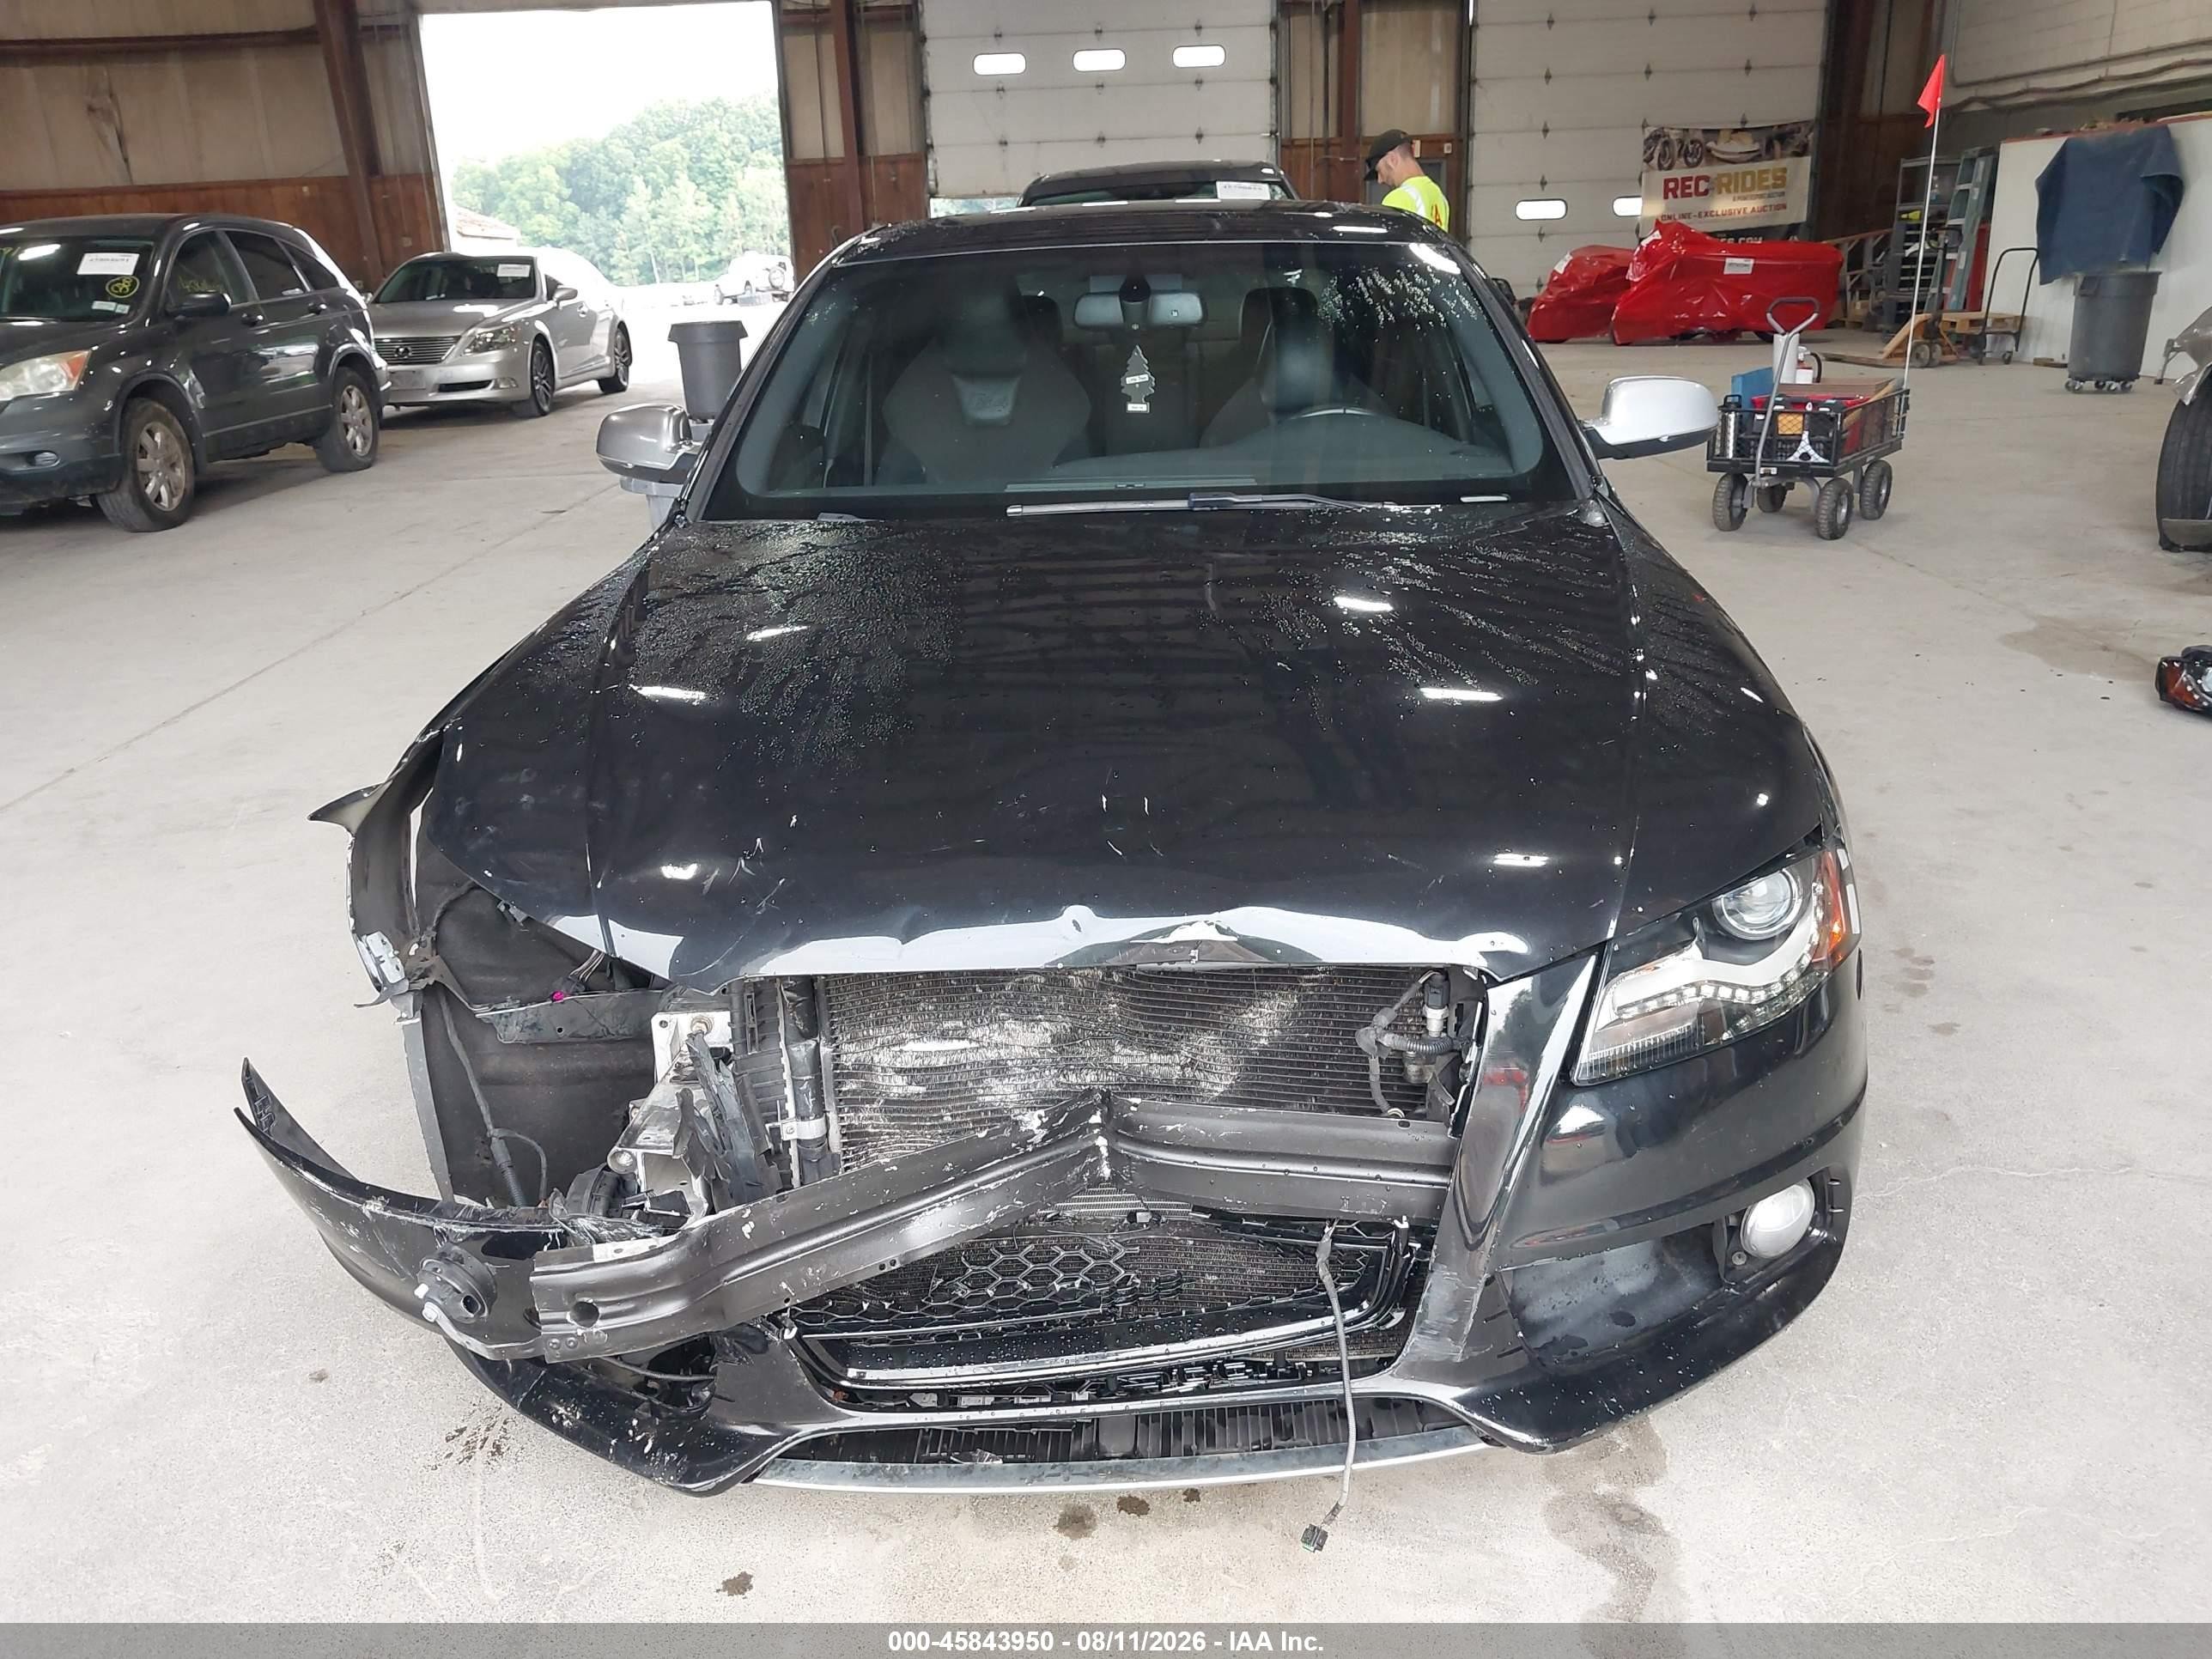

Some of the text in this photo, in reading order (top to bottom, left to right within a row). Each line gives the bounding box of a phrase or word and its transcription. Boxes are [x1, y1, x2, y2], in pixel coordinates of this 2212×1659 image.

[1662, 174, 1711, 200] REC
[1717, 167, 1788, 195] RIDES
[1661, 202, 1788, 222] ONLINE-EXCLUSIVE AUCTION
